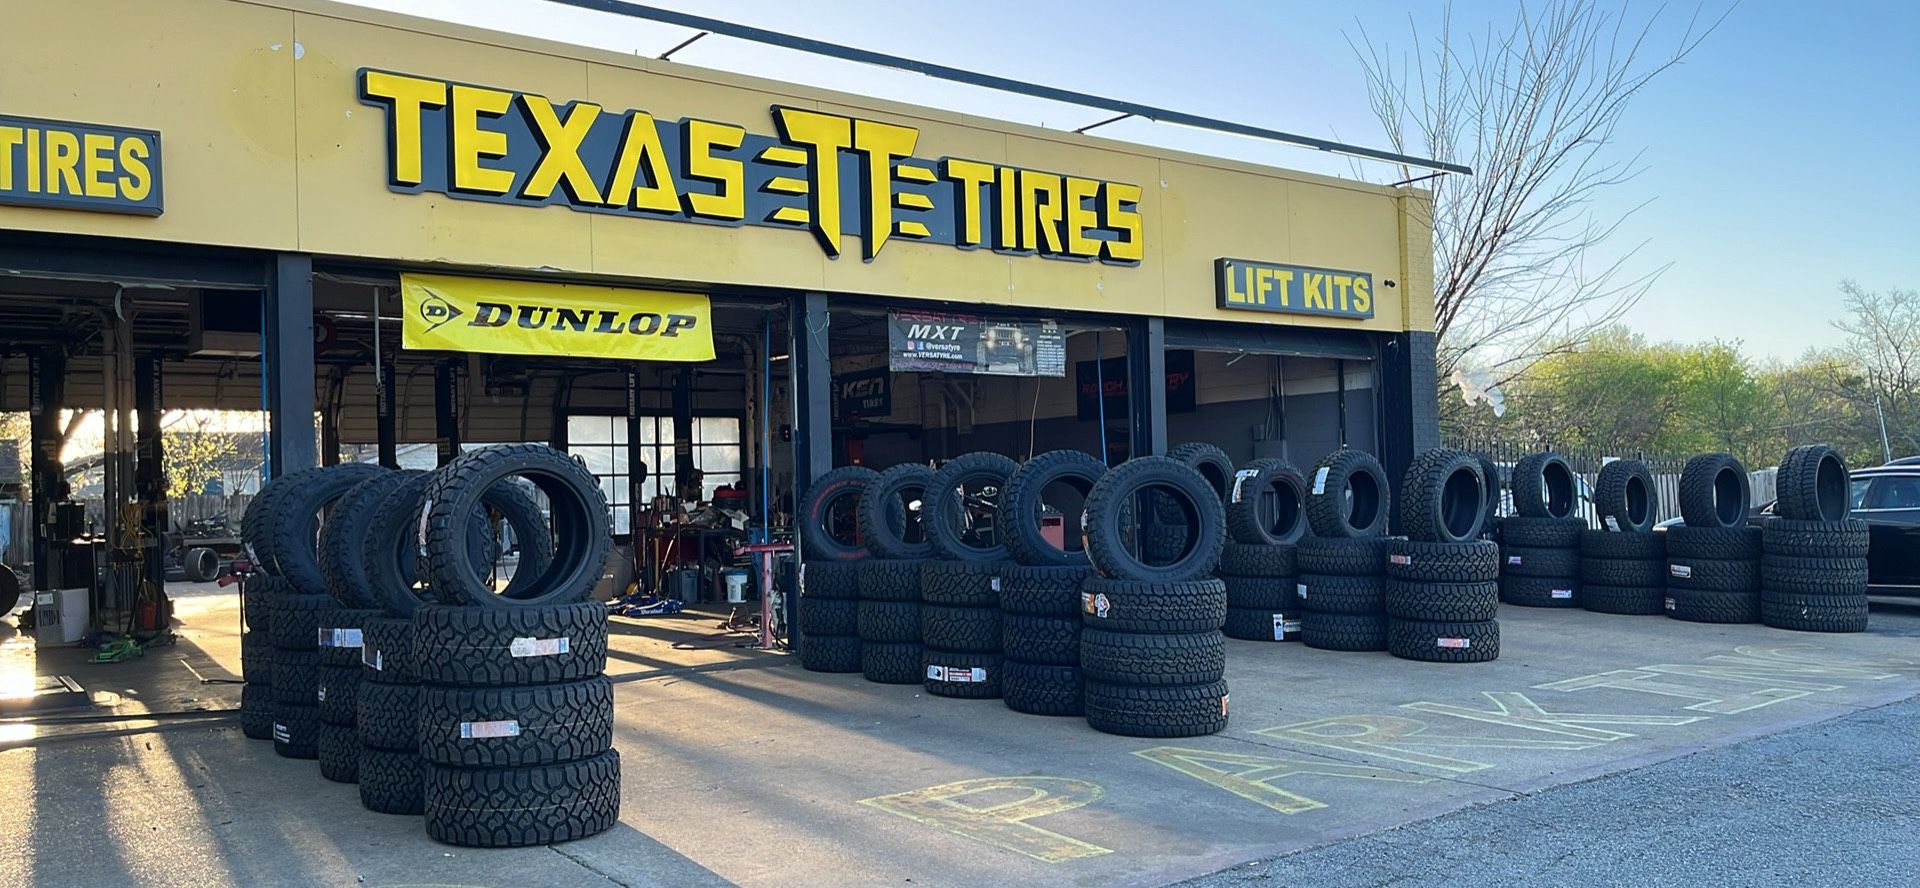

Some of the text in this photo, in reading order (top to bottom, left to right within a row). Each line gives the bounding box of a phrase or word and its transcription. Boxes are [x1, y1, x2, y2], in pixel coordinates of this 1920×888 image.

[0, 125, 152, 202] TIRES
[365, 70, 746, 220] TEXAS
[945, 157, 1144, 261] TIRES
[1226, 265, 1371, 313] LIFT KITS
[467, 301, 697, 338] DUNLOP
[907, 324, 965, 341] MXT
[902, 351, 963, 361] www.VERSATYRE.com
[925, 343, 961, 353] @versatyre
